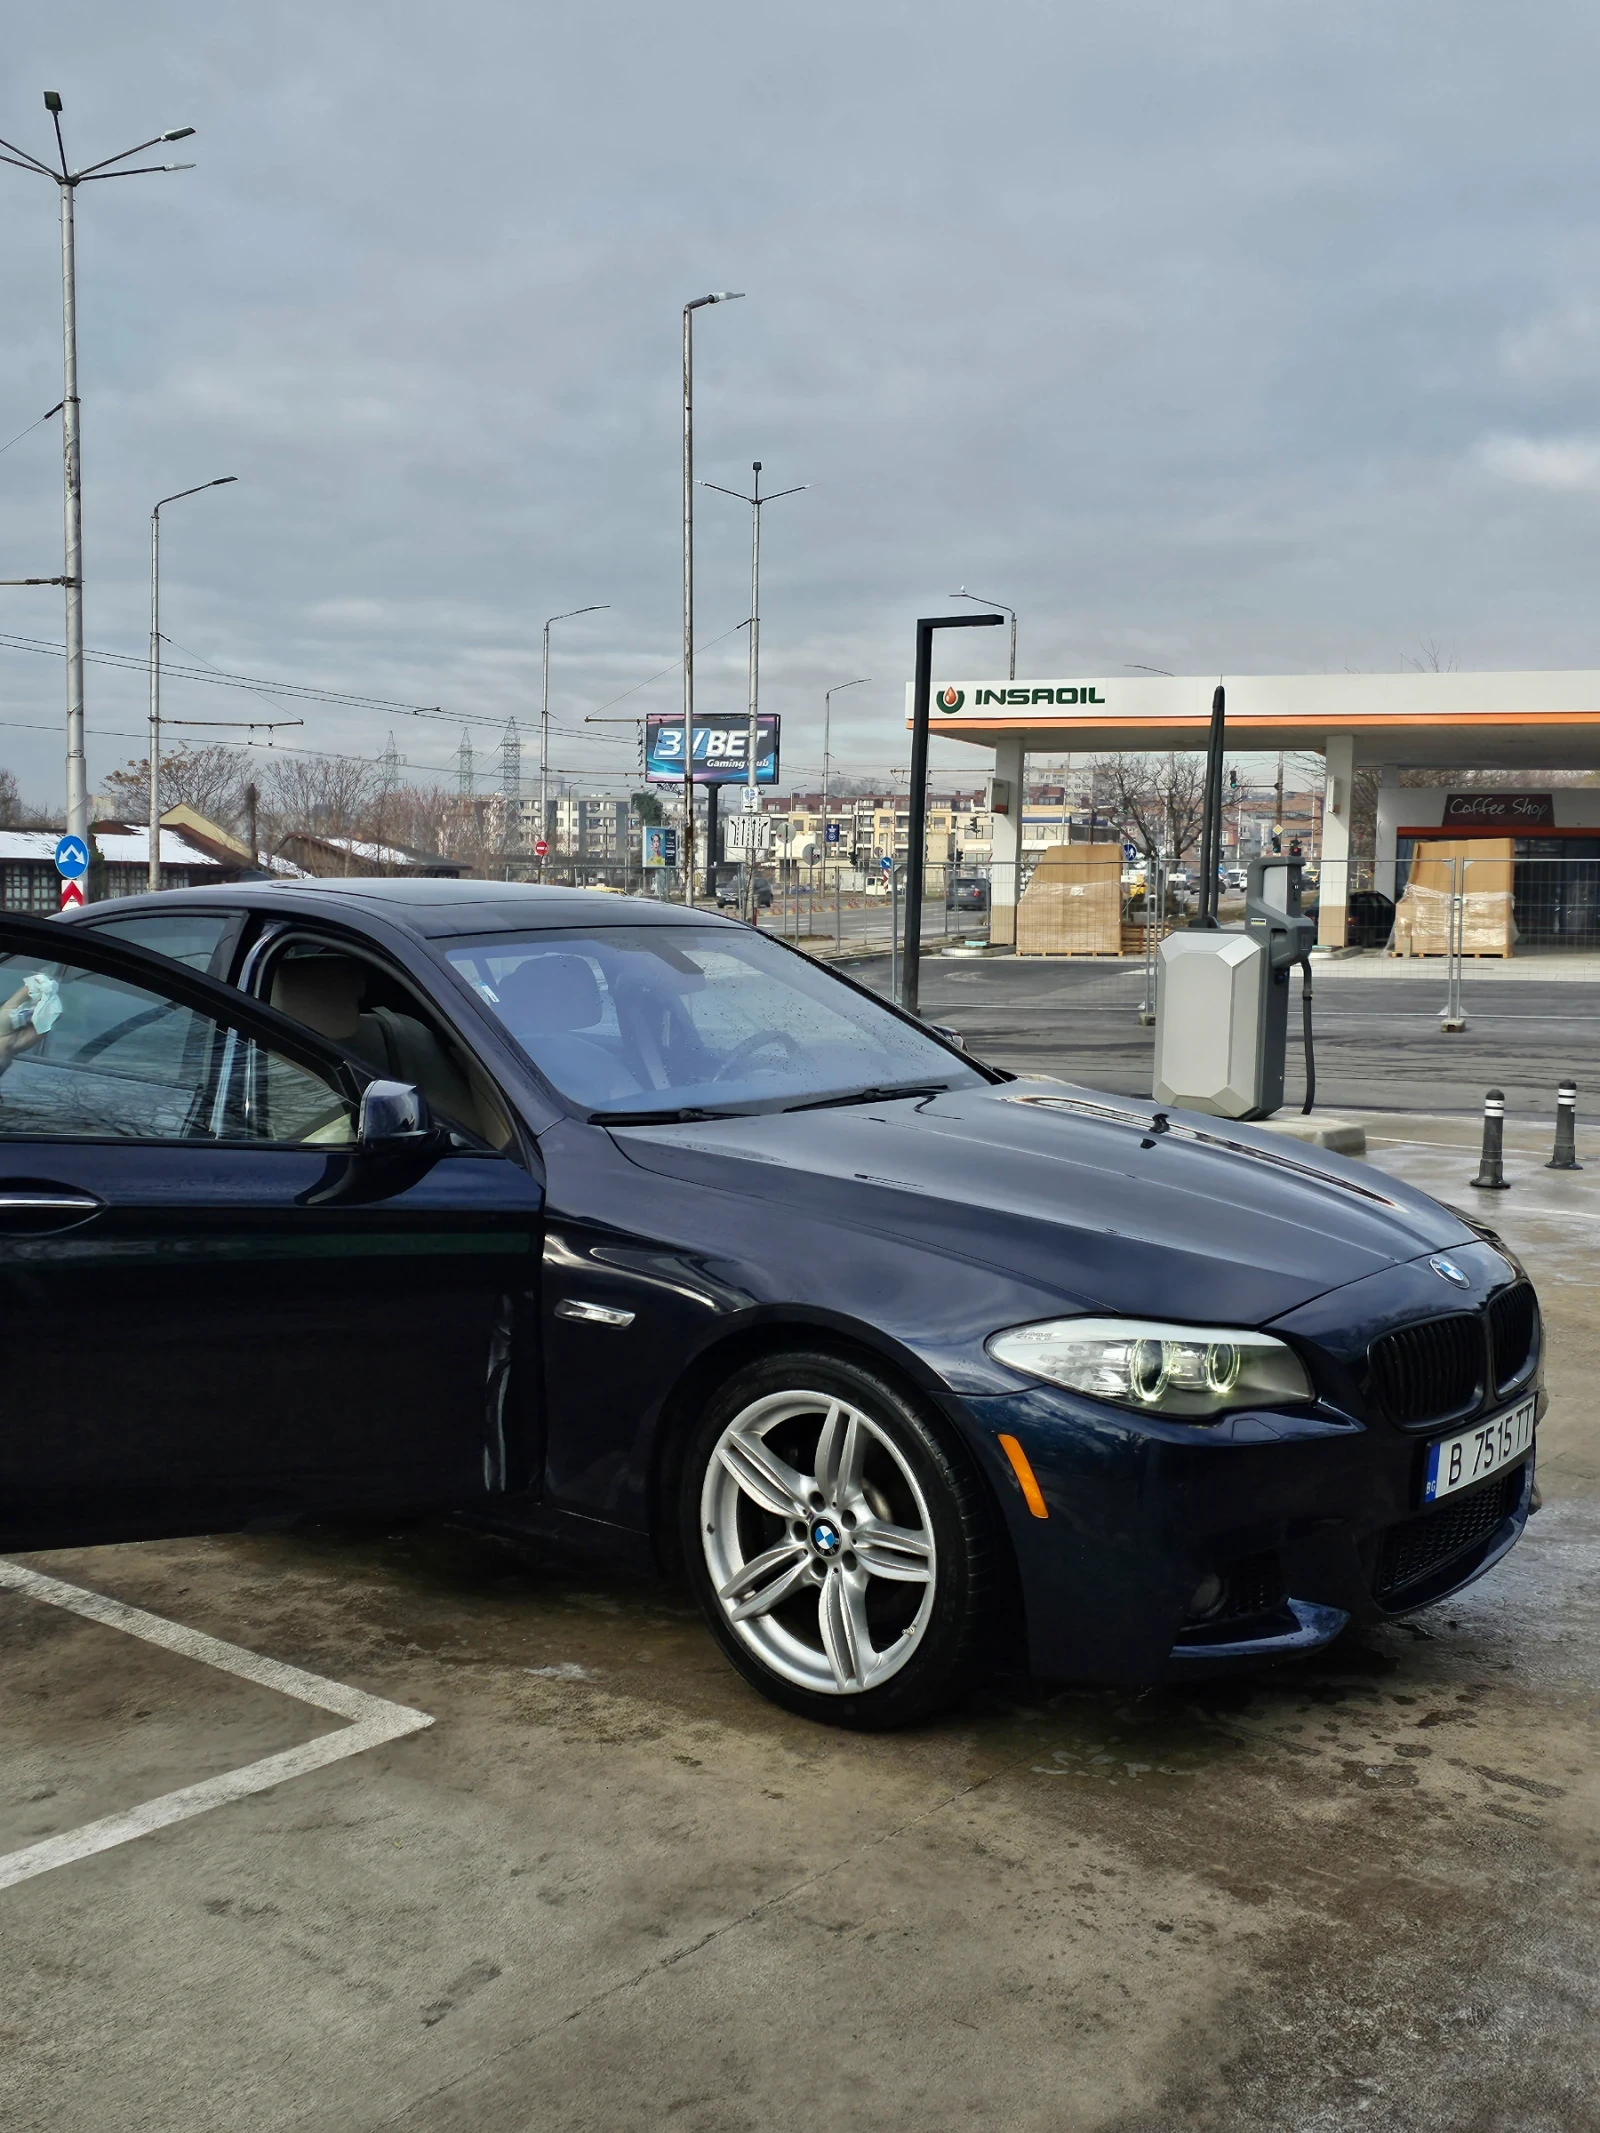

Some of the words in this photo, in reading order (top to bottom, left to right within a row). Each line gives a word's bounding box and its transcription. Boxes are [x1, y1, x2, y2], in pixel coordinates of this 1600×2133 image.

[975, 687, 1106, 706] INSAOIL
[706, 758, 745, 769] Gaming
[1449, 797, 1506, 815] Coffee
[1512, 797, 1548, 821] Shop
[1448, 1442, 1462, 1486] B
[1472, 1415, 1513, 1477] 7515
[1516, 1401, 1533, 1449] TT
[1426, 1480, 1436, 1495] BG
